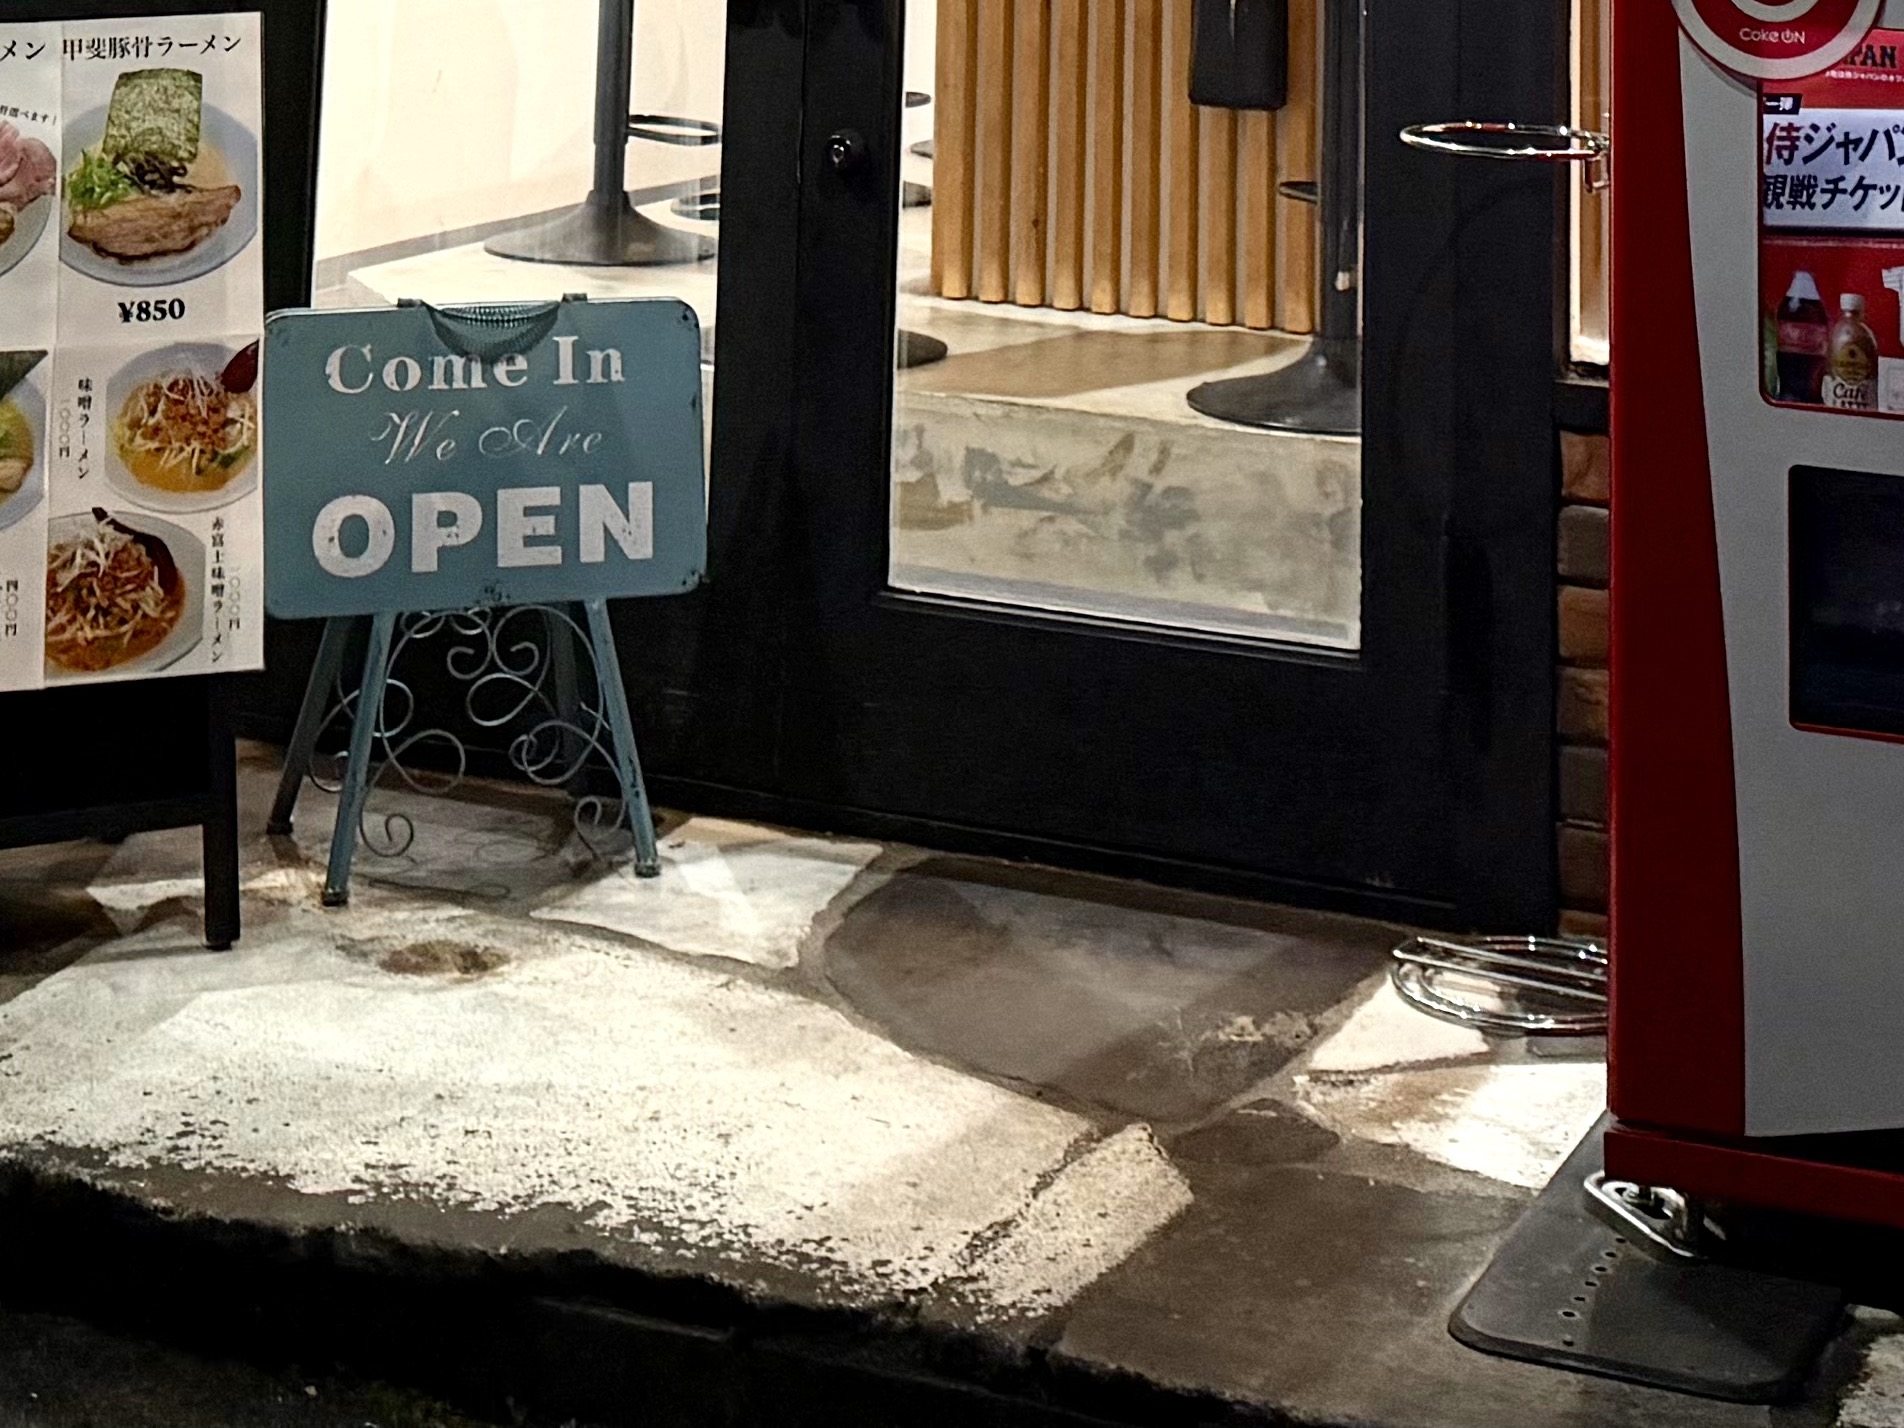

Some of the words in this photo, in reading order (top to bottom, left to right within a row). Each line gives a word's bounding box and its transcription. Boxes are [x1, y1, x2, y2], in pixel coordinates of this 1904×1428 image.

[62, 33, 243, 62] 甲斐豚骨ラーメン
[1739, 27, 1780, 42] Coke
[117, 297, 186, 324] ¥850
[324, 343, 528, 394] Come
[552, 335, 626, 386] In
[77, 378, 93, 480] 味噌ラーメン
[369, 409, 461, 464] We
[478, 405, 603, 459] Are
[311, 481, 654, 578] OPEN
